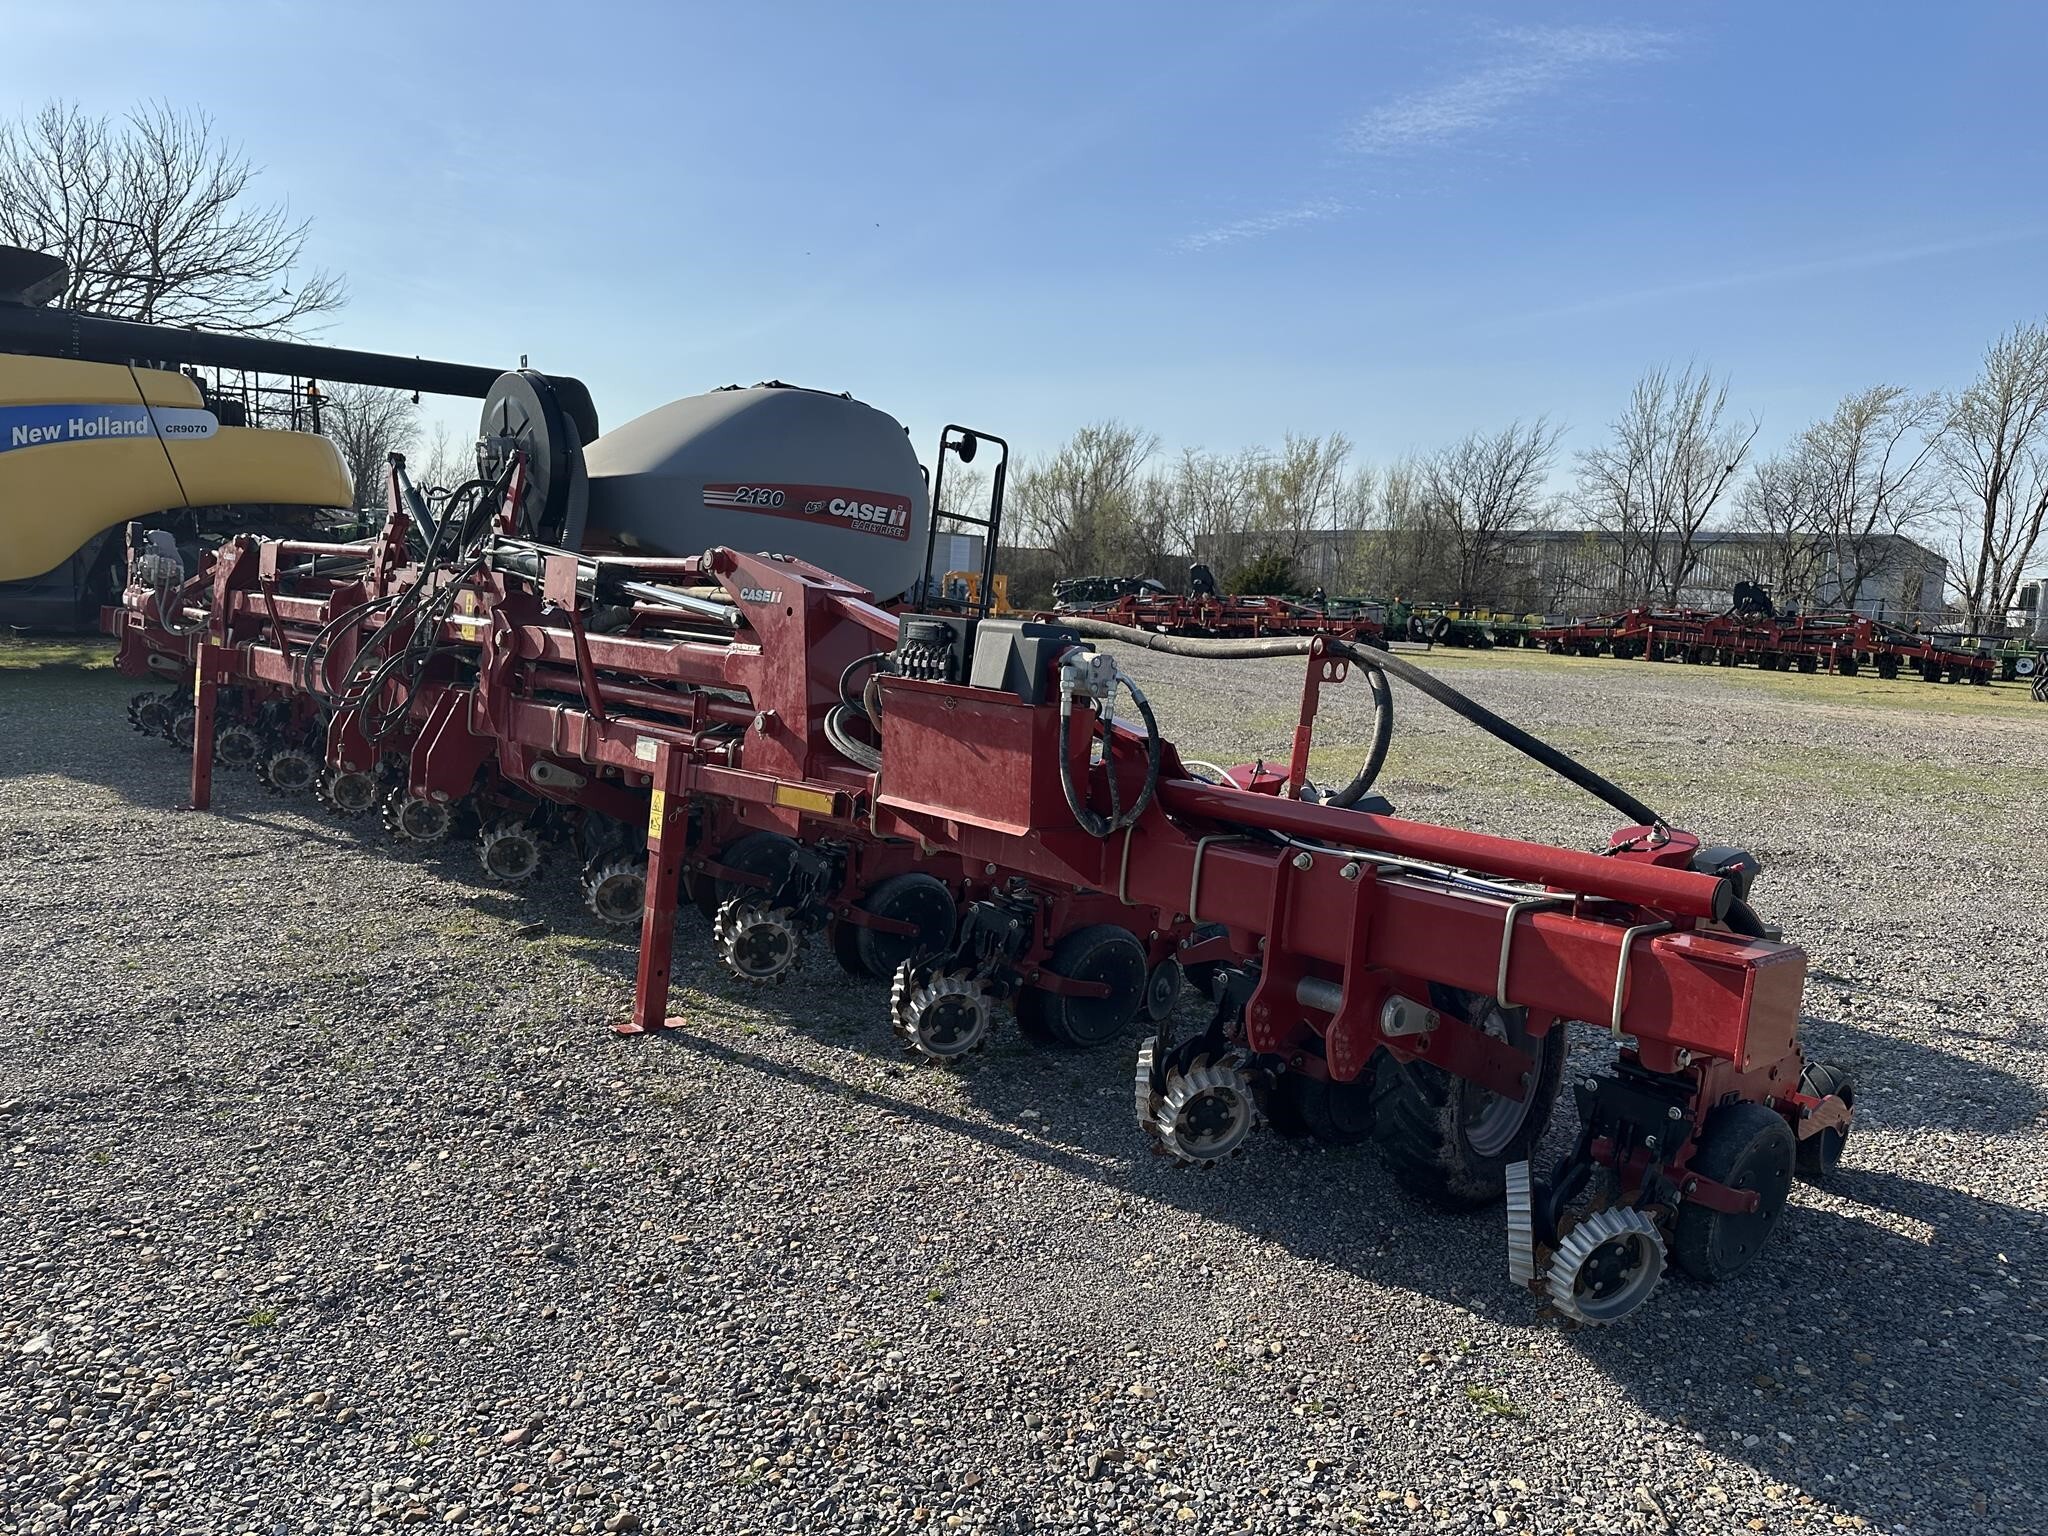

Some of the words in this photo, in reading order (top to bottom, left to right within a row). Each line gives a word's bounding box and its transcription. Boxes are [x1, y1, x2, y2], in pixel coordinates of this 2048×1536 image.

[12, 425, 61, 446] New
[68, 416, 148, 438] Holland
[165, 424, 208, 433] CR9070
[734, 486, 785, 508] 2130
[829, 498, 888, 523] CASE
[851, 520, 881, 533] EARLY
[880, 525, 905, 537] RISER
[740, 588, 771, 602] CASE
